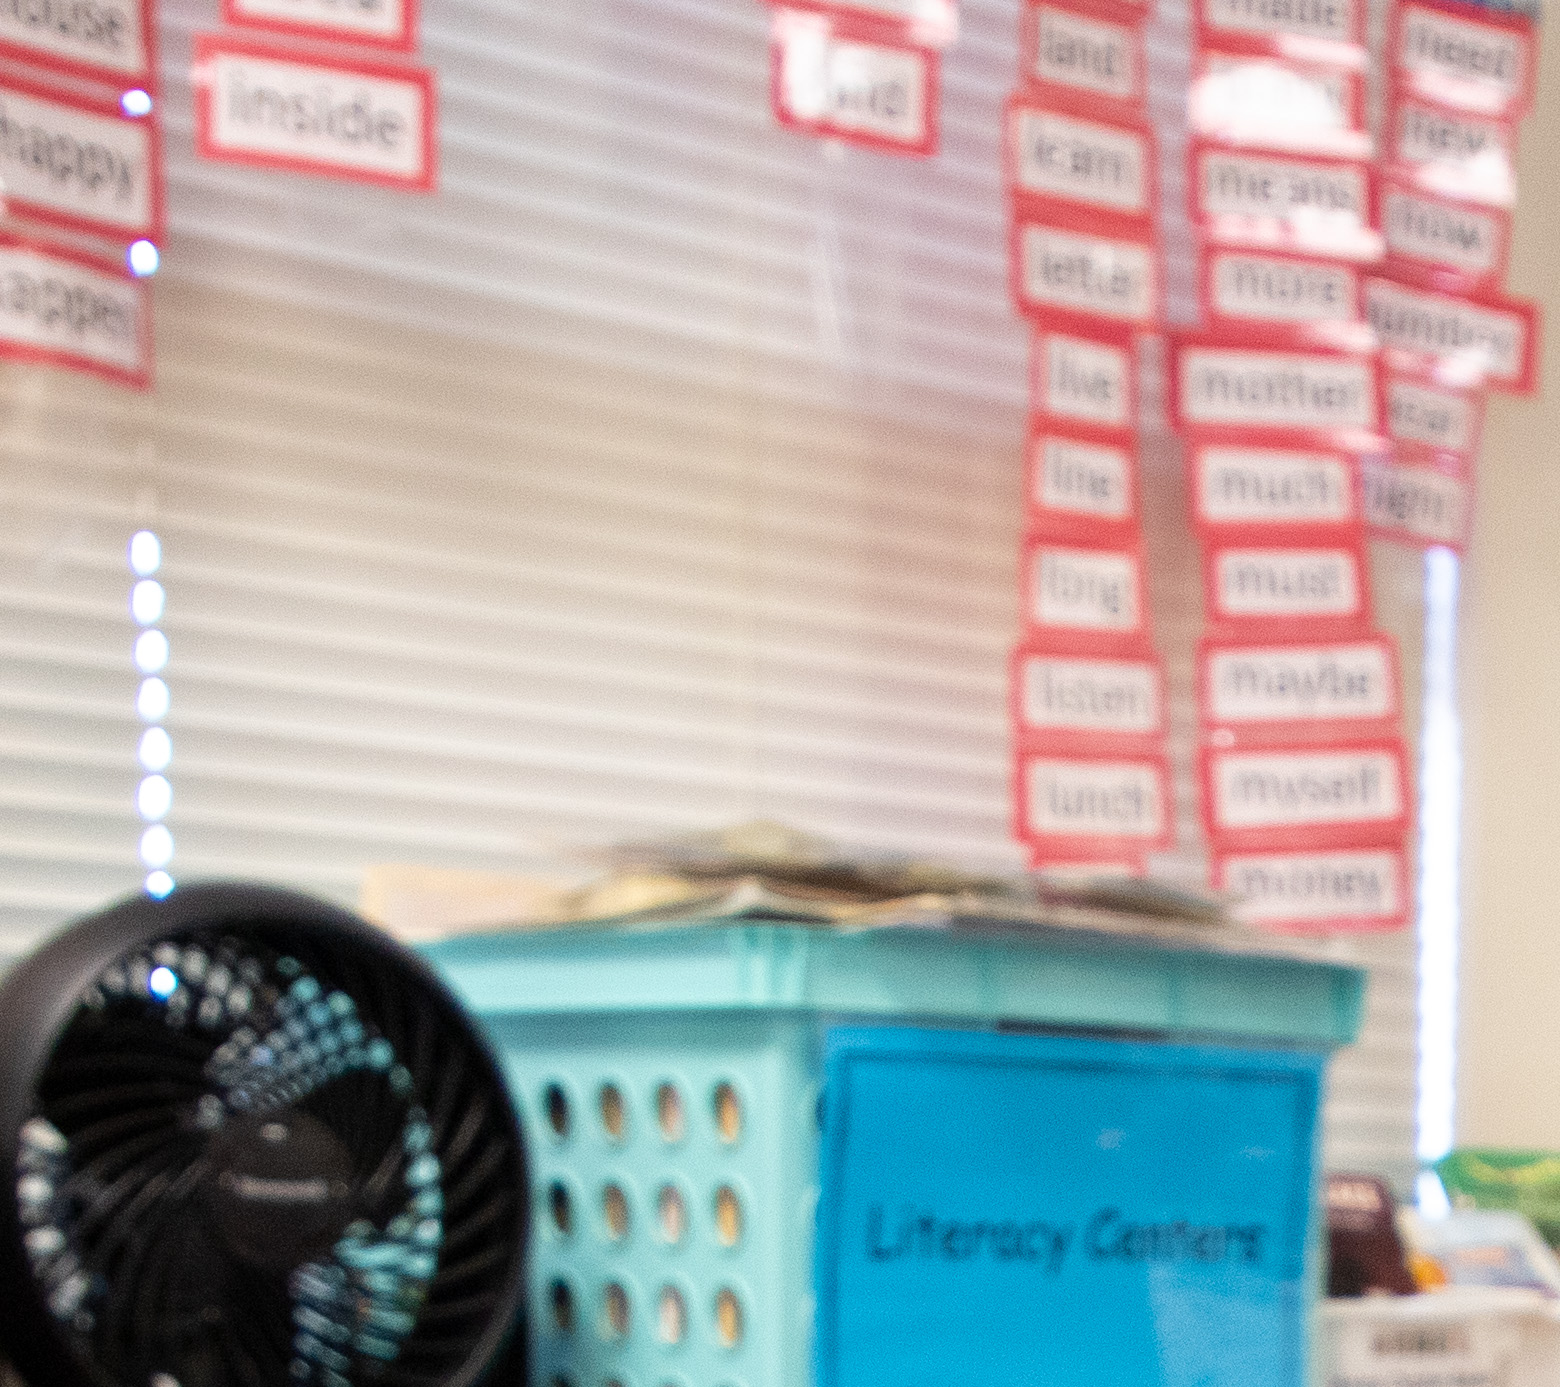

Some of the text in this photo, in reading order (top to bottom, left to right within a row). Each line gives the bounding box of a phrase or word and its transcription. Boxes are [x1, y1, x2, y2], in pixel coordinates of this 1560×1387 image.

[228, 75, 403, 150] inside
[1203, 364, 1353, 412] mother
[1227, 650, 1375, 710] maybe
[1237, 758, 1381, 817] myself
[867, 1203, 1268, 1278] Literacy Centers
